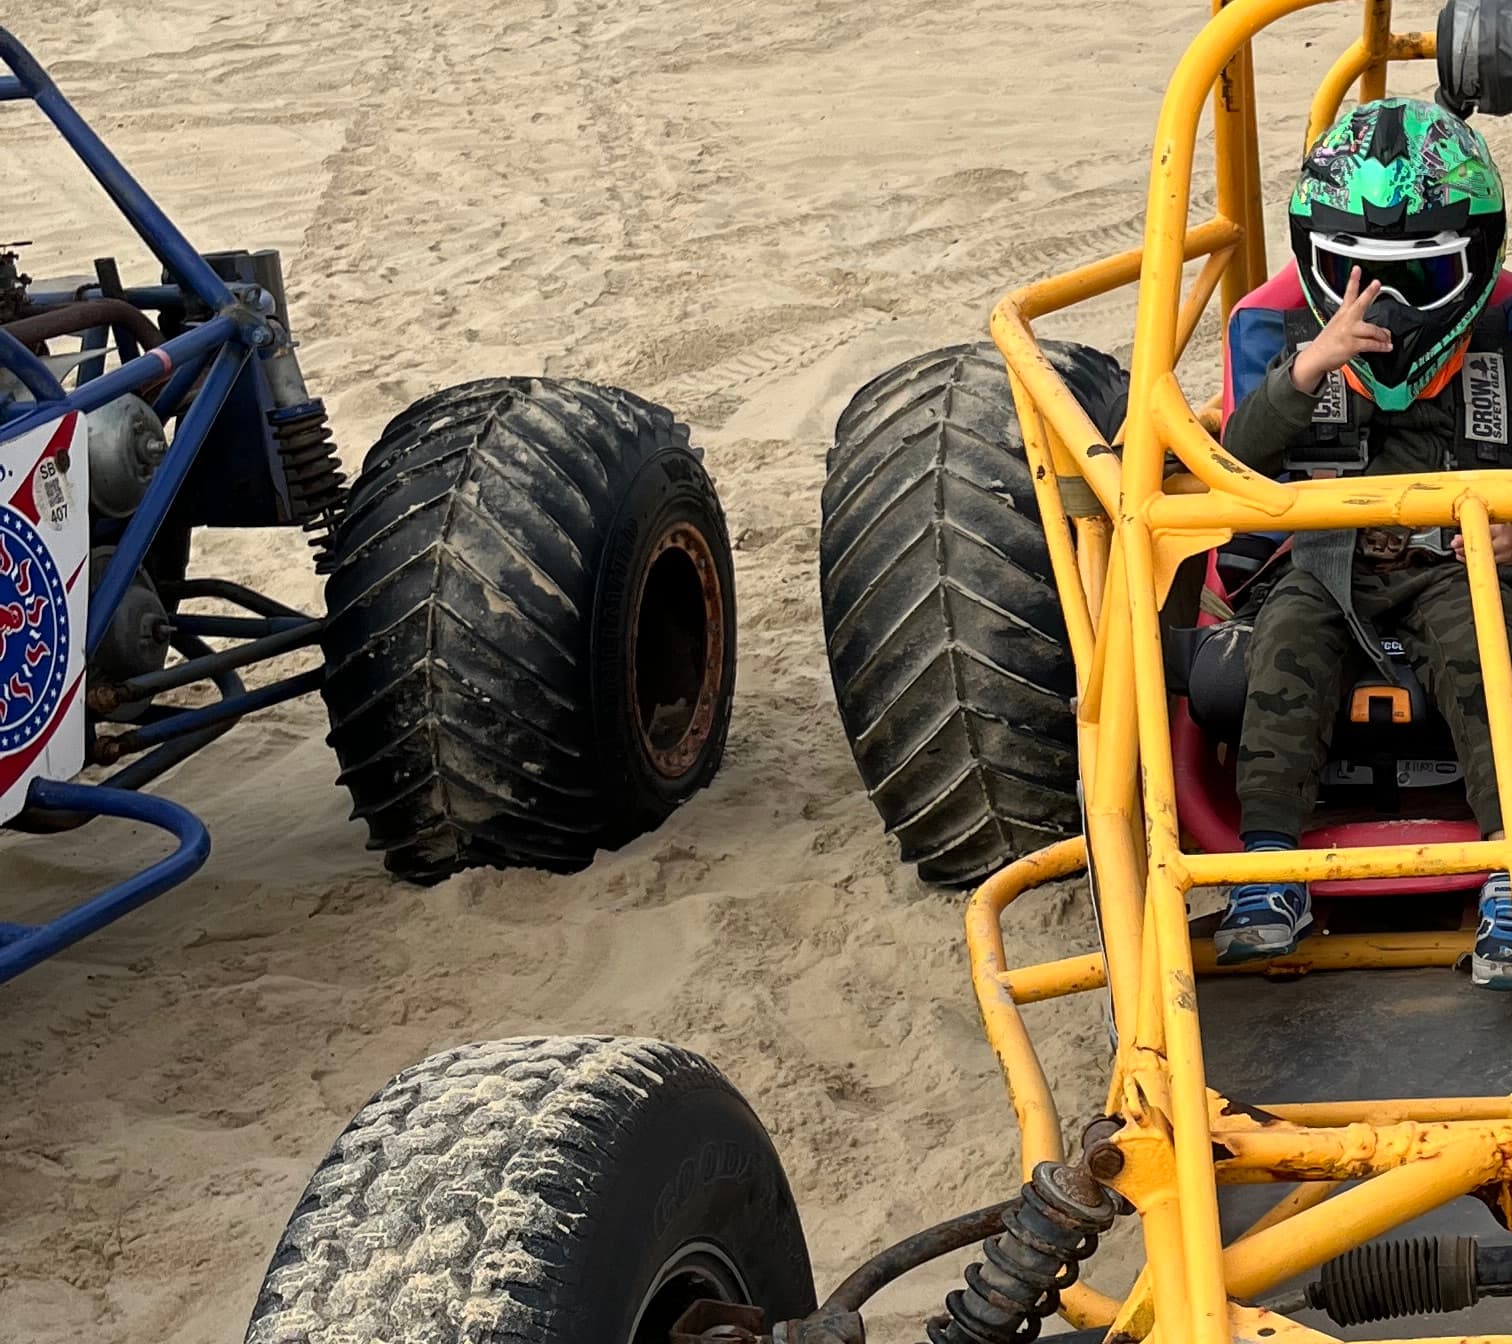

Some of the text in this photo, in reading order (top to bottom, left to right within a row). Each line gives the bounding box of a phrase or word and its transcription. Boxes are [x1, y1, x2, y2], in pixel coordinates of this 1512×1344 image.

[1330, 371, 1341, 418] SAFETY
[1470, 377, 1493, 437] CROW
[1489, 357, 1502, 439] SAFETY GEAR
[40, 462, 56, 480] SB
[51, 504, 68, 523] 407
